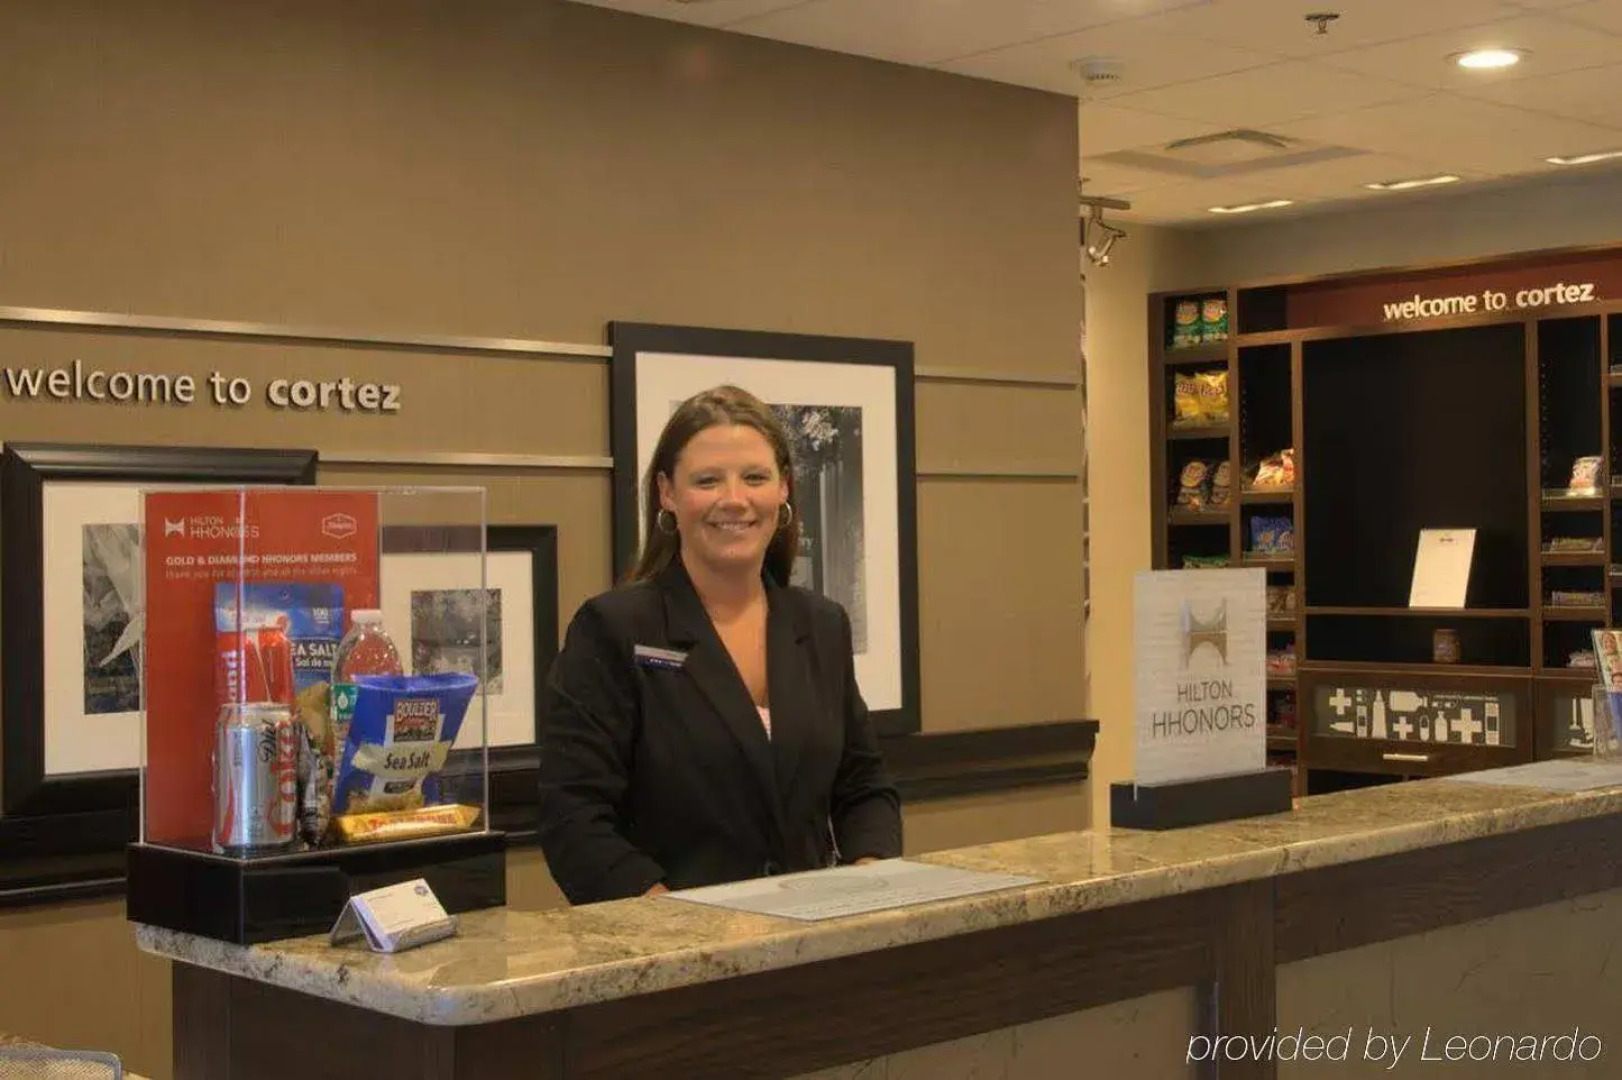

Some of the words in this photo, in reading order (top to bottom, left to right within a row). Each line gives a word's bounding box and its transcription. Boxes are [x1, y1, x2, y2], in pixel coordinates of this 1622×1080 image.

[1383, 294, 1477, 320] welcome
[1482, 290, 1507, 311] to
[1516, 283, 1595, 307] cortez
[5, 359, 195, 403] welcome
[210, 370, 252, 404] to
[267, 376, 402, 410] cortez
[190, 515, 224, 526] HILTON
[166, 556, 195, 566] GOLD
[207, 555, 260, 565] DIAMND
[310, 552, 358, 563] MEMBERS
[1177, 678, 1233, 703] HILTON
[1152, 703, 1256, 738] HHONORS
[384, 752, 407, 770] Sea
[407, 751, 431, 770] Salt
